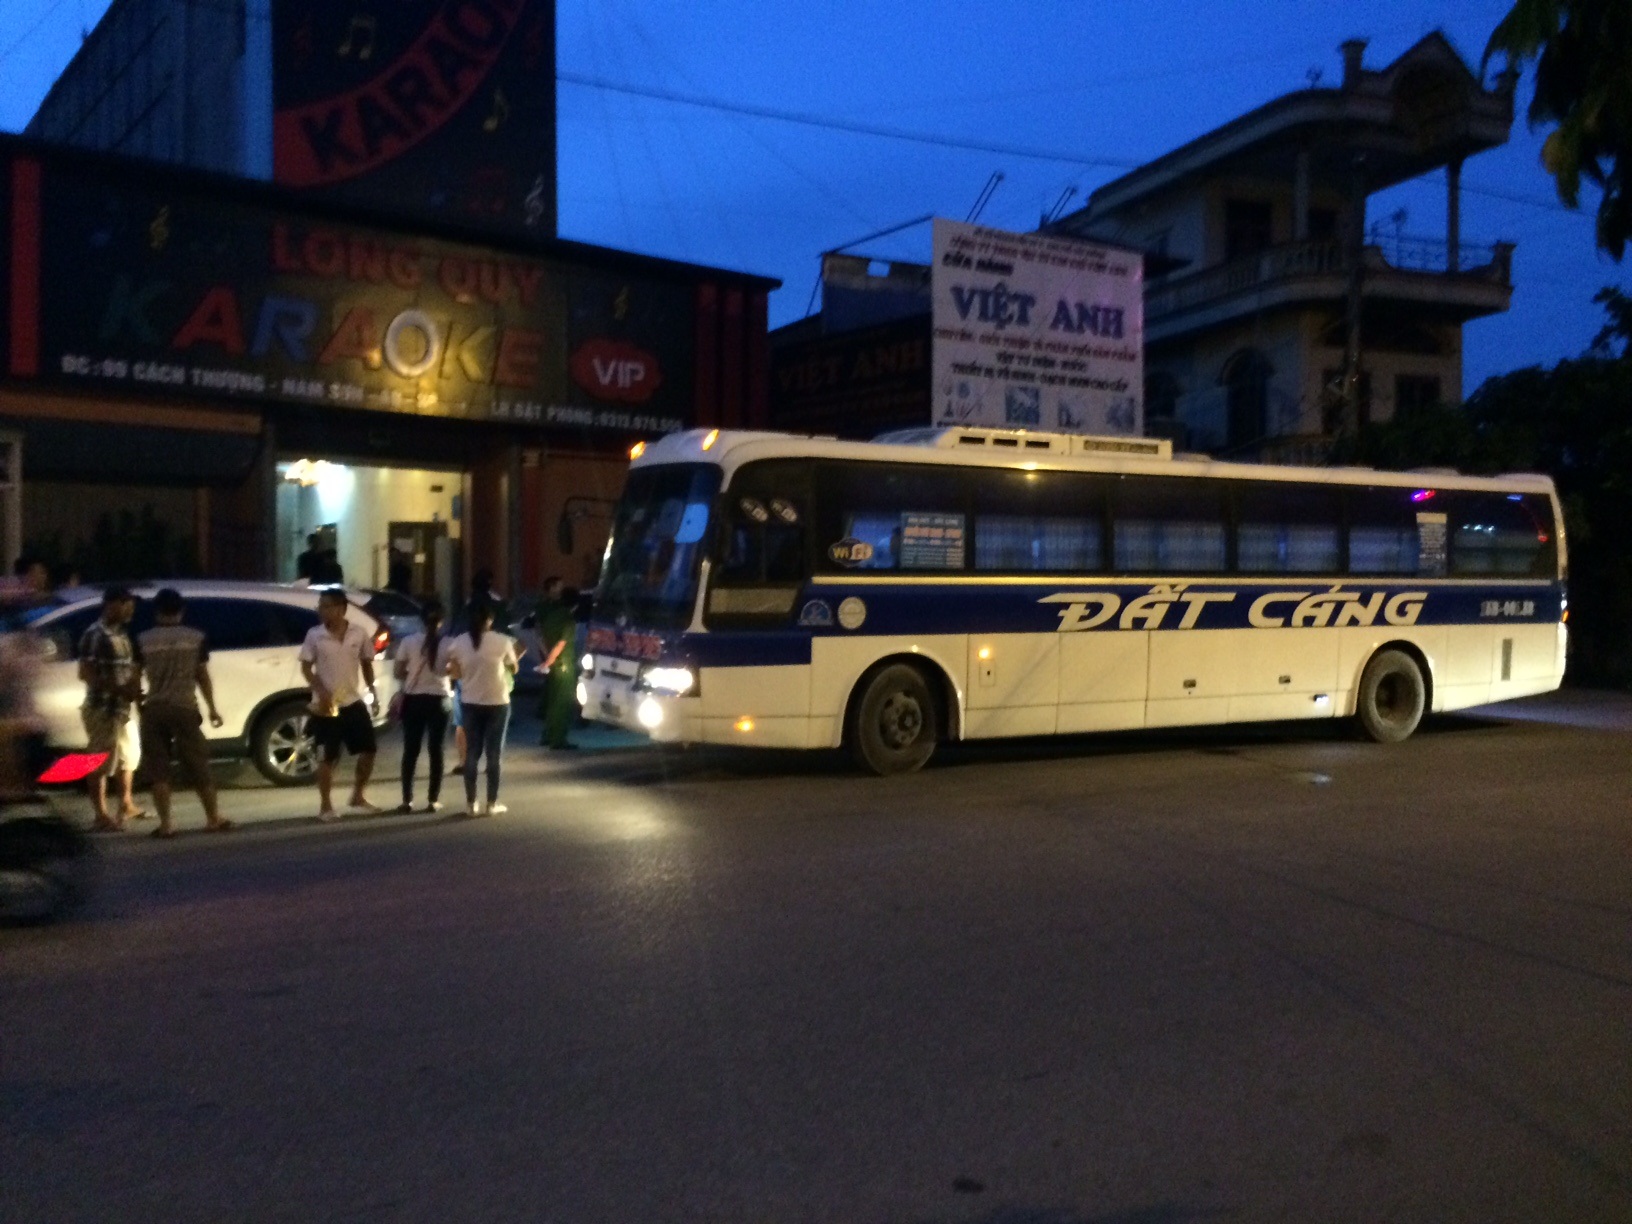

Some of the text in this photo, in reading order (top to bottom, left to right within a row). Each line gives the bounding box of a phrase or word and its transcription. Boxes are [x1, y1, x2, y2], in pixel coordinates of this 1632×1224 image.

[301, 0, 512, 172] KARAO
[270, 224, 421, 291] LONG
[98, 278, 546, 390] KARAOKE
[950, 282, 1125, 340] VIỆT ANH
[132, 361, 186, 385] CÁCH
[592, 357, 647, 389] VIP
[1037, 583, 1237, 632] ĐẤT
[1247, 584, 1429, 629] CẢNG
